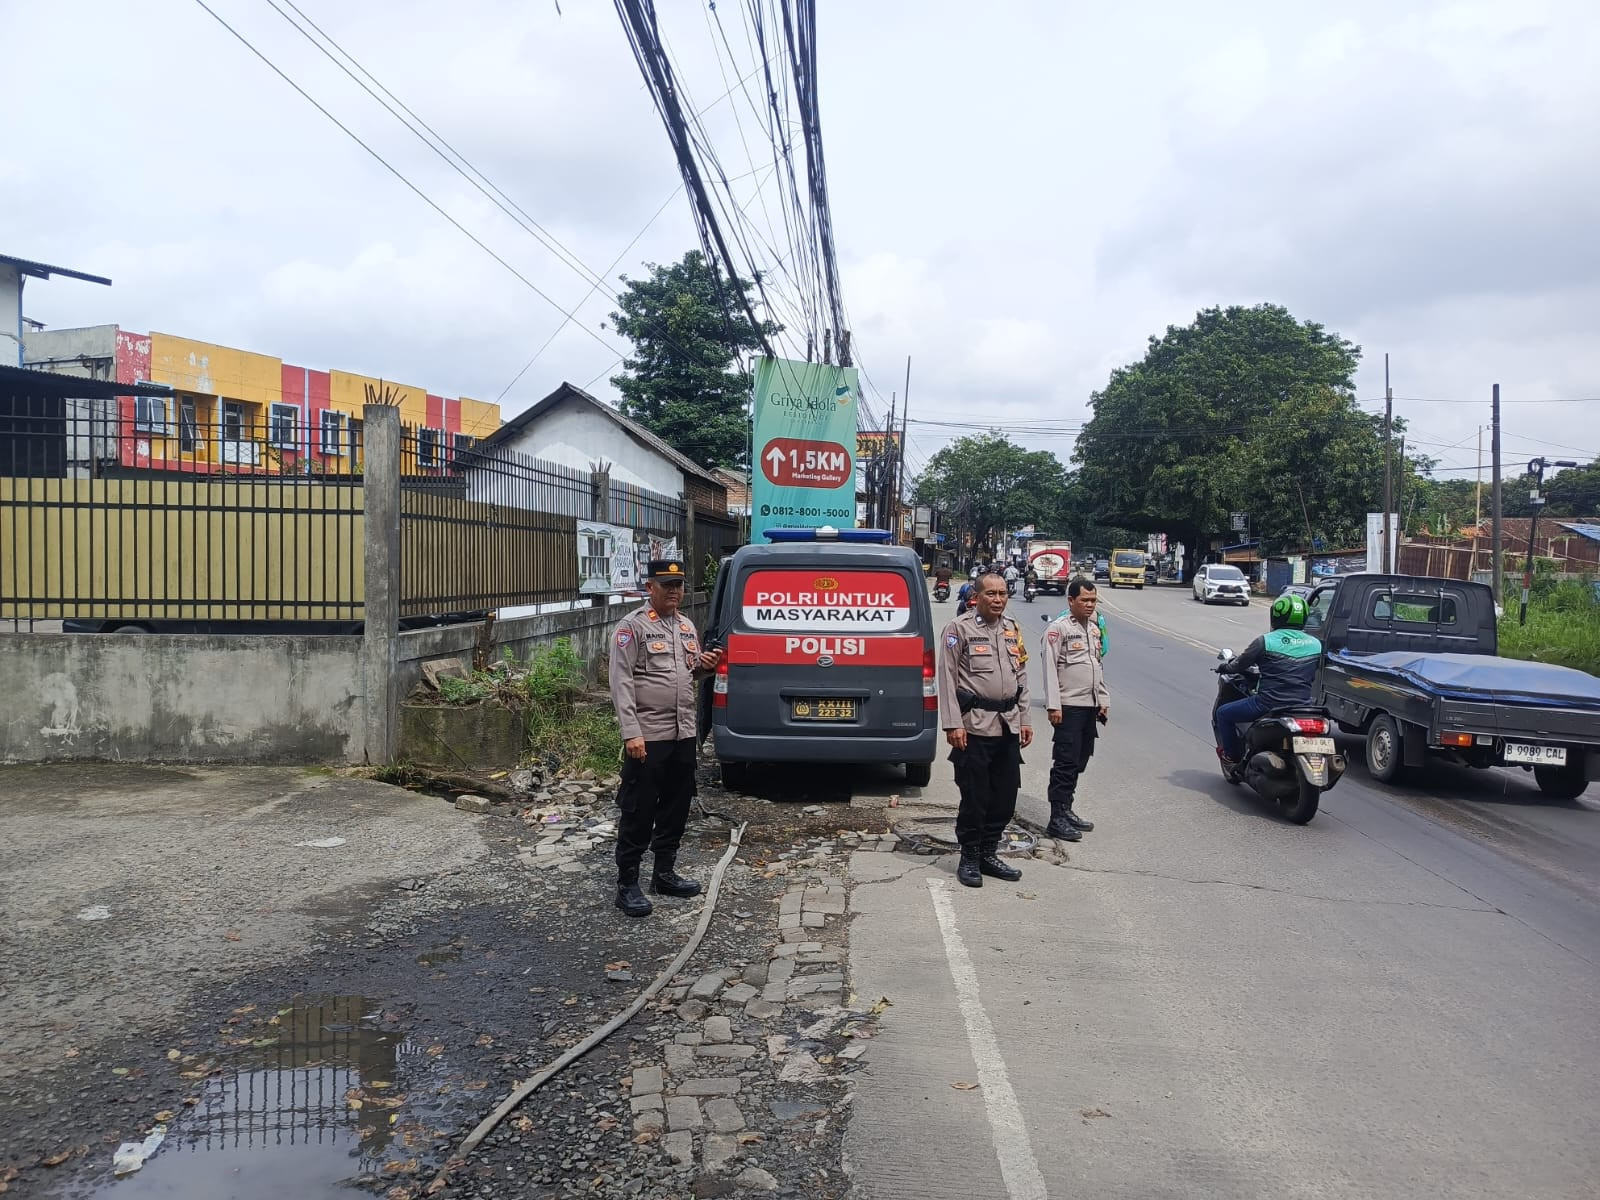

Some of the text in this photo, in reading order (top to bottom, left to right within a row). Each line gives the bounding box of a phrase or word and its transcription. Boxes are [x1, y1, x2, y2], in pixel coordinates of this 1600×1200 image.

[770, 392, 837, 412] Griya Idola
[789, 448, 845, 472] 1,5KM
[791, 472, 821, 481] Marketing
[756, 591, 895, 607] POLRI UNTUK
[756, 608, 895, 622] MASYARAKAT
[785, 637, 866, 656] POLISI
[818, 709, 852, 717] 223-32
[1507, 744, 1513, 755] B
[1517, 745, 1541, 757] 9989
[1546, 748, 1564, 760] CAL
